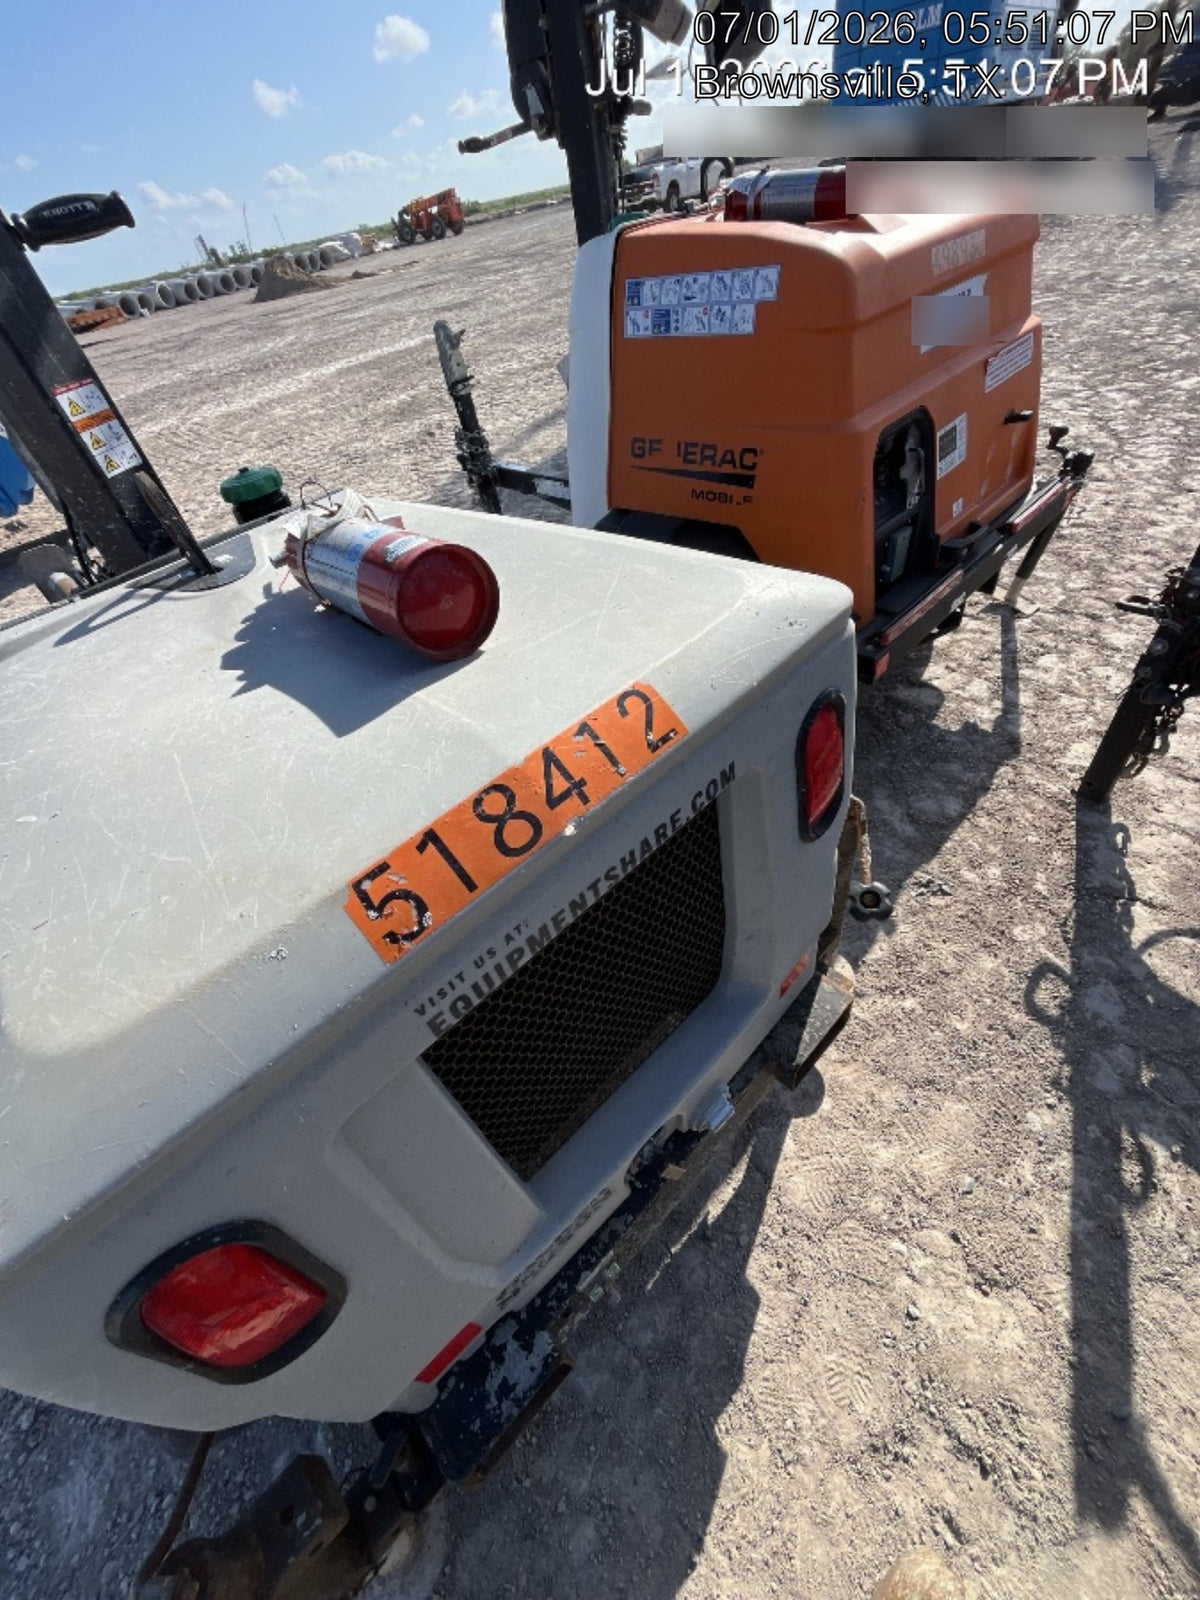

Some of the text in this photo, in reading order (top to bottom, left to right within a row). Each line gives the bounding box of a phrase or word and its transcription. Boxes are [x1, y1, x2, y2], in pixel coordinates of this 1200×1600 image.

[351, 688, 680, 945] 518412
[426, 759, 736, 1038] EQUIPMENTSHARE.COM
[413, 971, 467, 1017] VISIT
[473, 946, 498, 970] US
